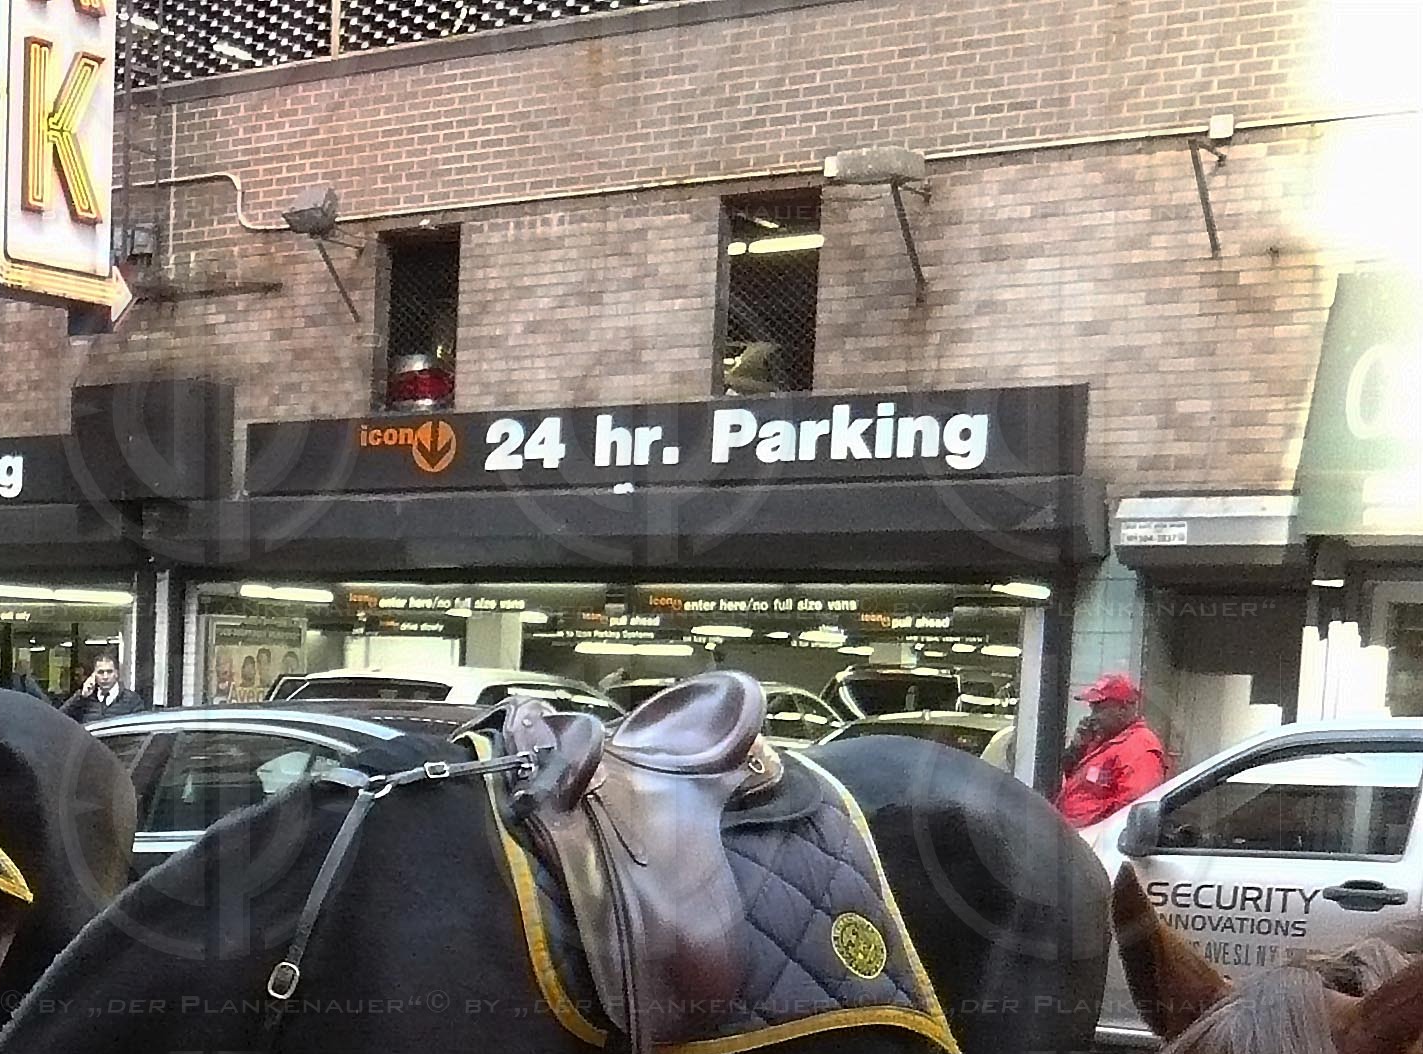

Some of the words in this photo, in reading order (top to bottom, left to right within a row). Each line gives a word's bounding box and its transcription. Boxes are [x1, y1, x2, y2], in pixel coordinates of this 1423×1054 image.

[22, 0, 105, 224] K
[361, 424, 413, 447] icon
[484, 416, 566, 471] 24
[594, 413, 680, 467] hr.
[711, 401, 989, 470] Parking
[683, 599, 717, 611] enter
[719, 598, 769, 611] here/no
[773, 598, 793, 611] full
[797, 599, 823, 611] size
[827, 600, 857, 611] vans
[1146, 881, 1322, 914] SECURITY
[1158, 912, 1307, 938] NNOVATIONS
